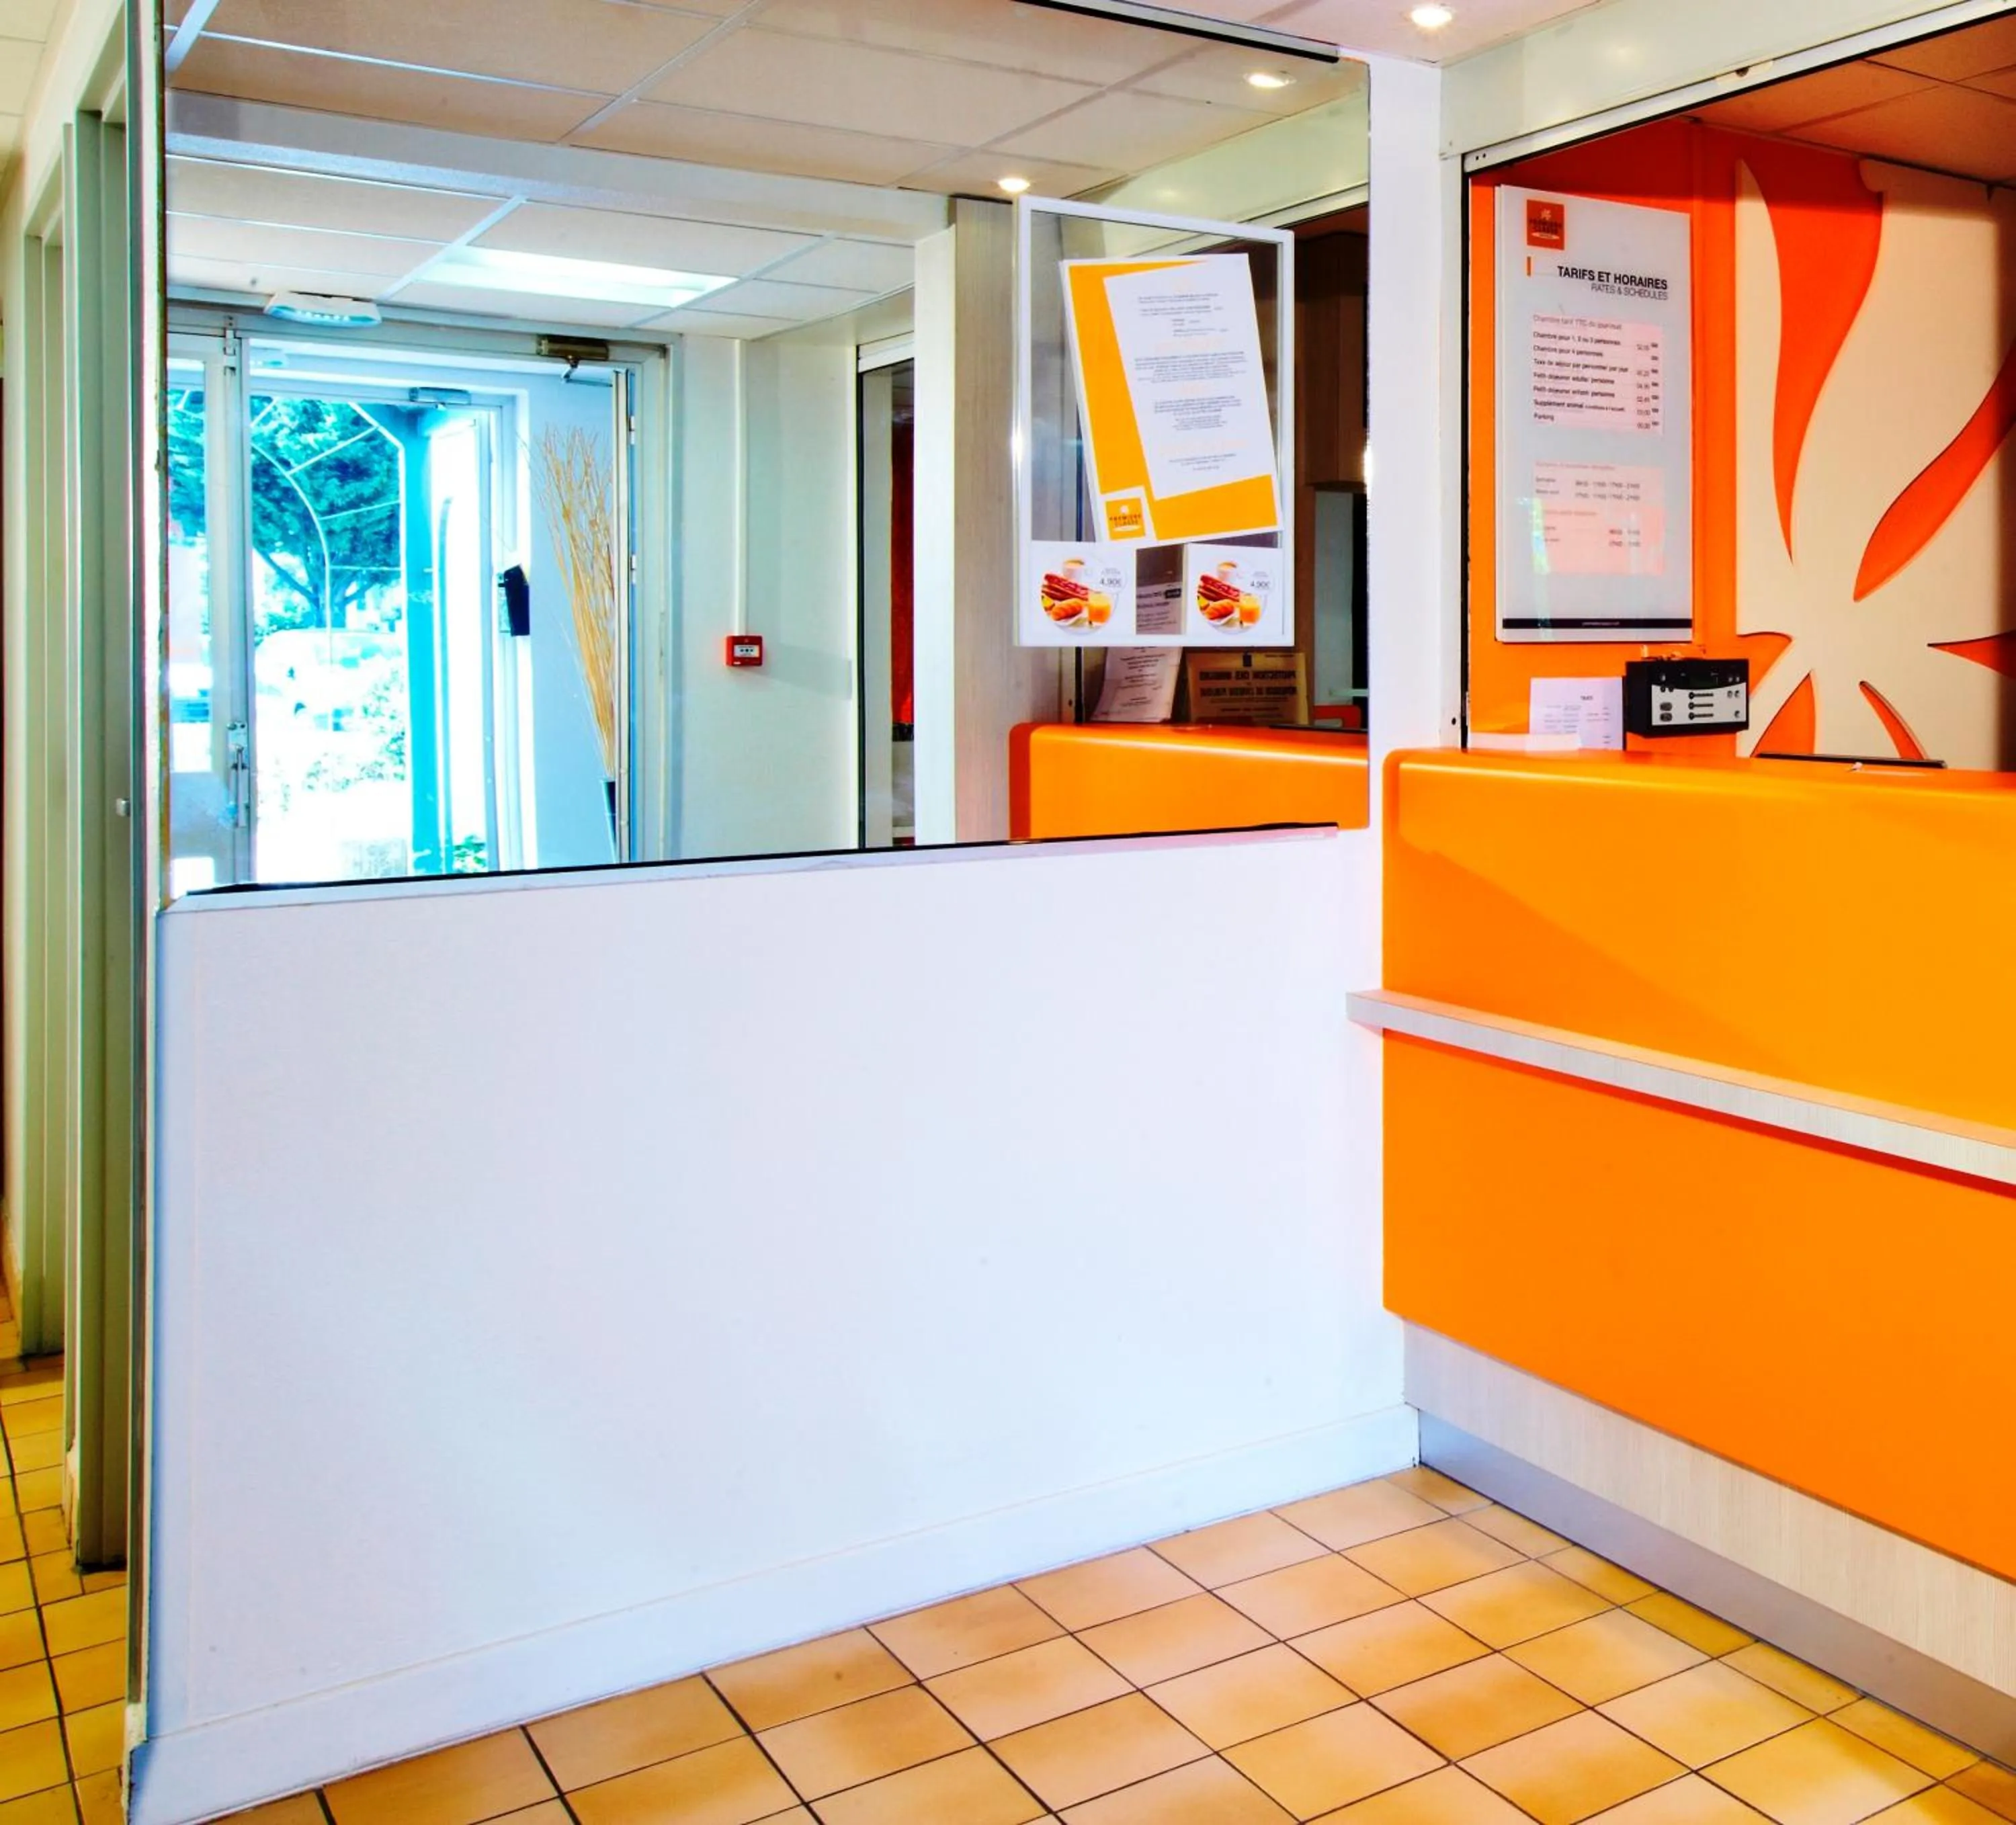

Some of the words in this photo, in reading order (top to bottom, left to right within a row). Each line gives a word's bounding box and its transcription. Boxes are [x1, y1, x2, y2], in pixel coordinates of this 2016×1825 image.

[1557, 265, 1595, 281] TARIFS
[1597, 271, 1611, 282] ET
[1613, 273, 1667, 290] HORAIRES
[1591, 283, 1615, 294] RATES
[1624, 287, 1668, 300] SCHEDULES
